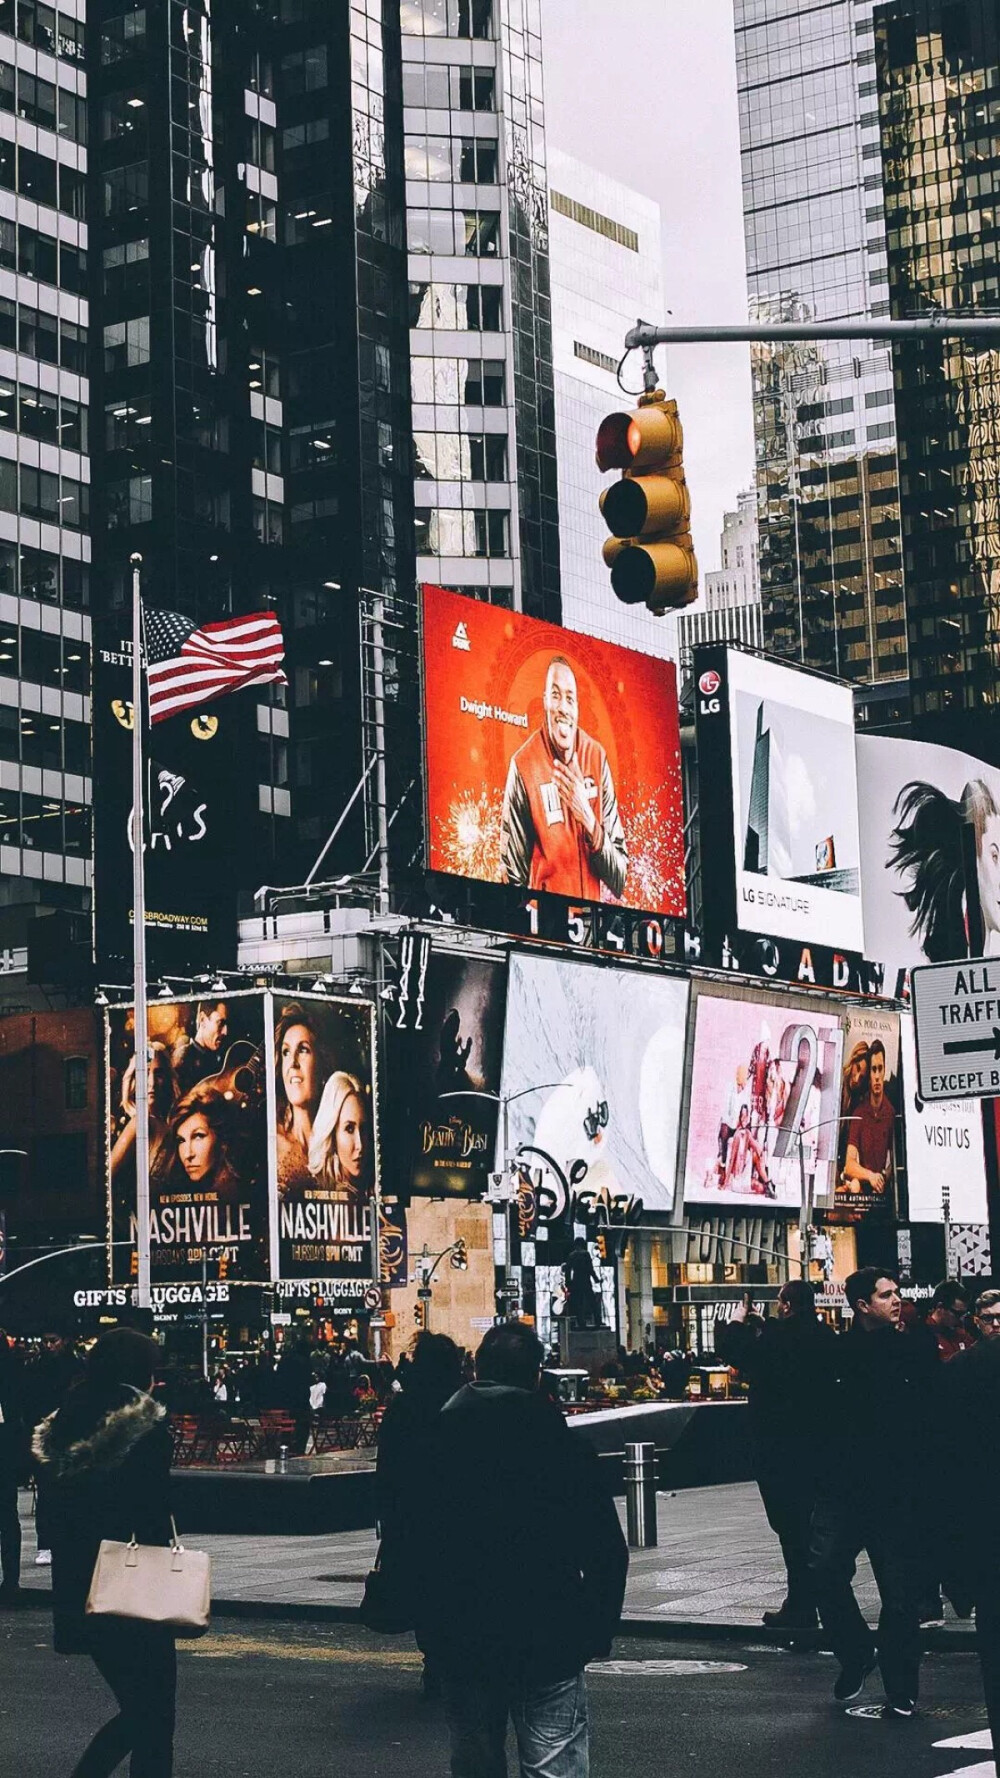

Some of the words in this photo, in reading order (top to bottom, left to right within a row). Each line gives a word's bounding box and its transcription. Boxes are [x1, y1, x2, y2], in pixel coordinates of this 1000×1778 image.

[120, 640, 144, 654] ITS
[100, 650, 148, 669] BETTR
[460, 697, 492, 719] Dwight
[494, 706, 528, 728] Howard
[700, 698, 720, 714] LG
[742, 887, 755, 903] LG
[757, 890, 809, 914] SIGNATURE
[128, 909, 208, 925] CSBROADWAY.COM
[954, 967, 997, 996] ALL
[863, 1019, 878, 1030] POLO
[930, 1072, 984, 1092] EXCEPT
[924, 1125, 953, 1148] VISIT
[955, 1127, 971, 1149] US
[281, 1202, 371, 1241] NASHVILLE
[341, 1245, 363, 1262] CMT
[73, 1289, 127, 1307] GIFTS
[150, 1285, 230, 1304] UGGAGE
[276, 1281, 311, 1298] GIFTS
[899, 1283, 928, 1303] sunglass
[153, 1314, 178, 1322] SONY
